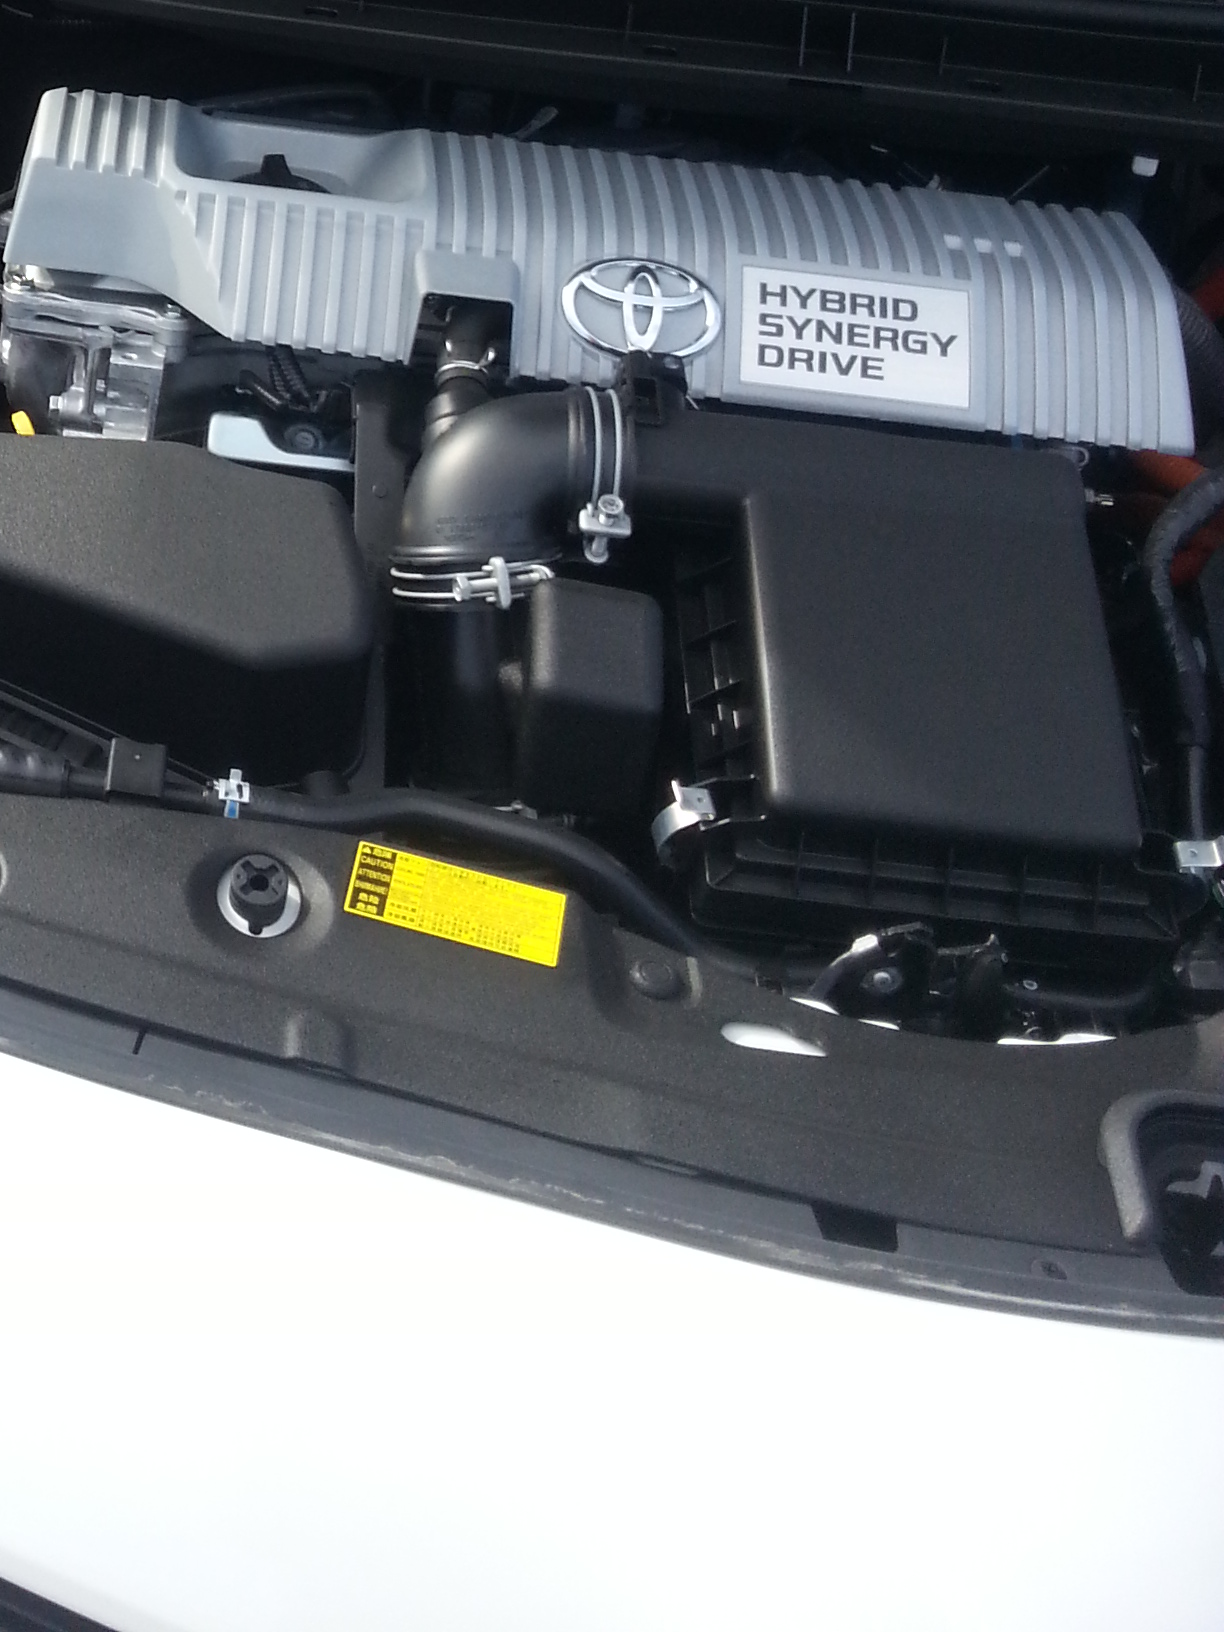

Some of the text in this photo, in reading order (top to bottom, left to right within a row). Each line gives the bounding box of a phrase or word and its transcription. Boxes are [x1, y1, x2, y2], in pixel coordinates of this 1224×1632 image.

[759, 282, 918, 322] HYBRID
[758, 313, 958, 357] SYNERGY
[757, 343, 885, 380] DRIVE
[360, 855, 394, 870] CAUTION
